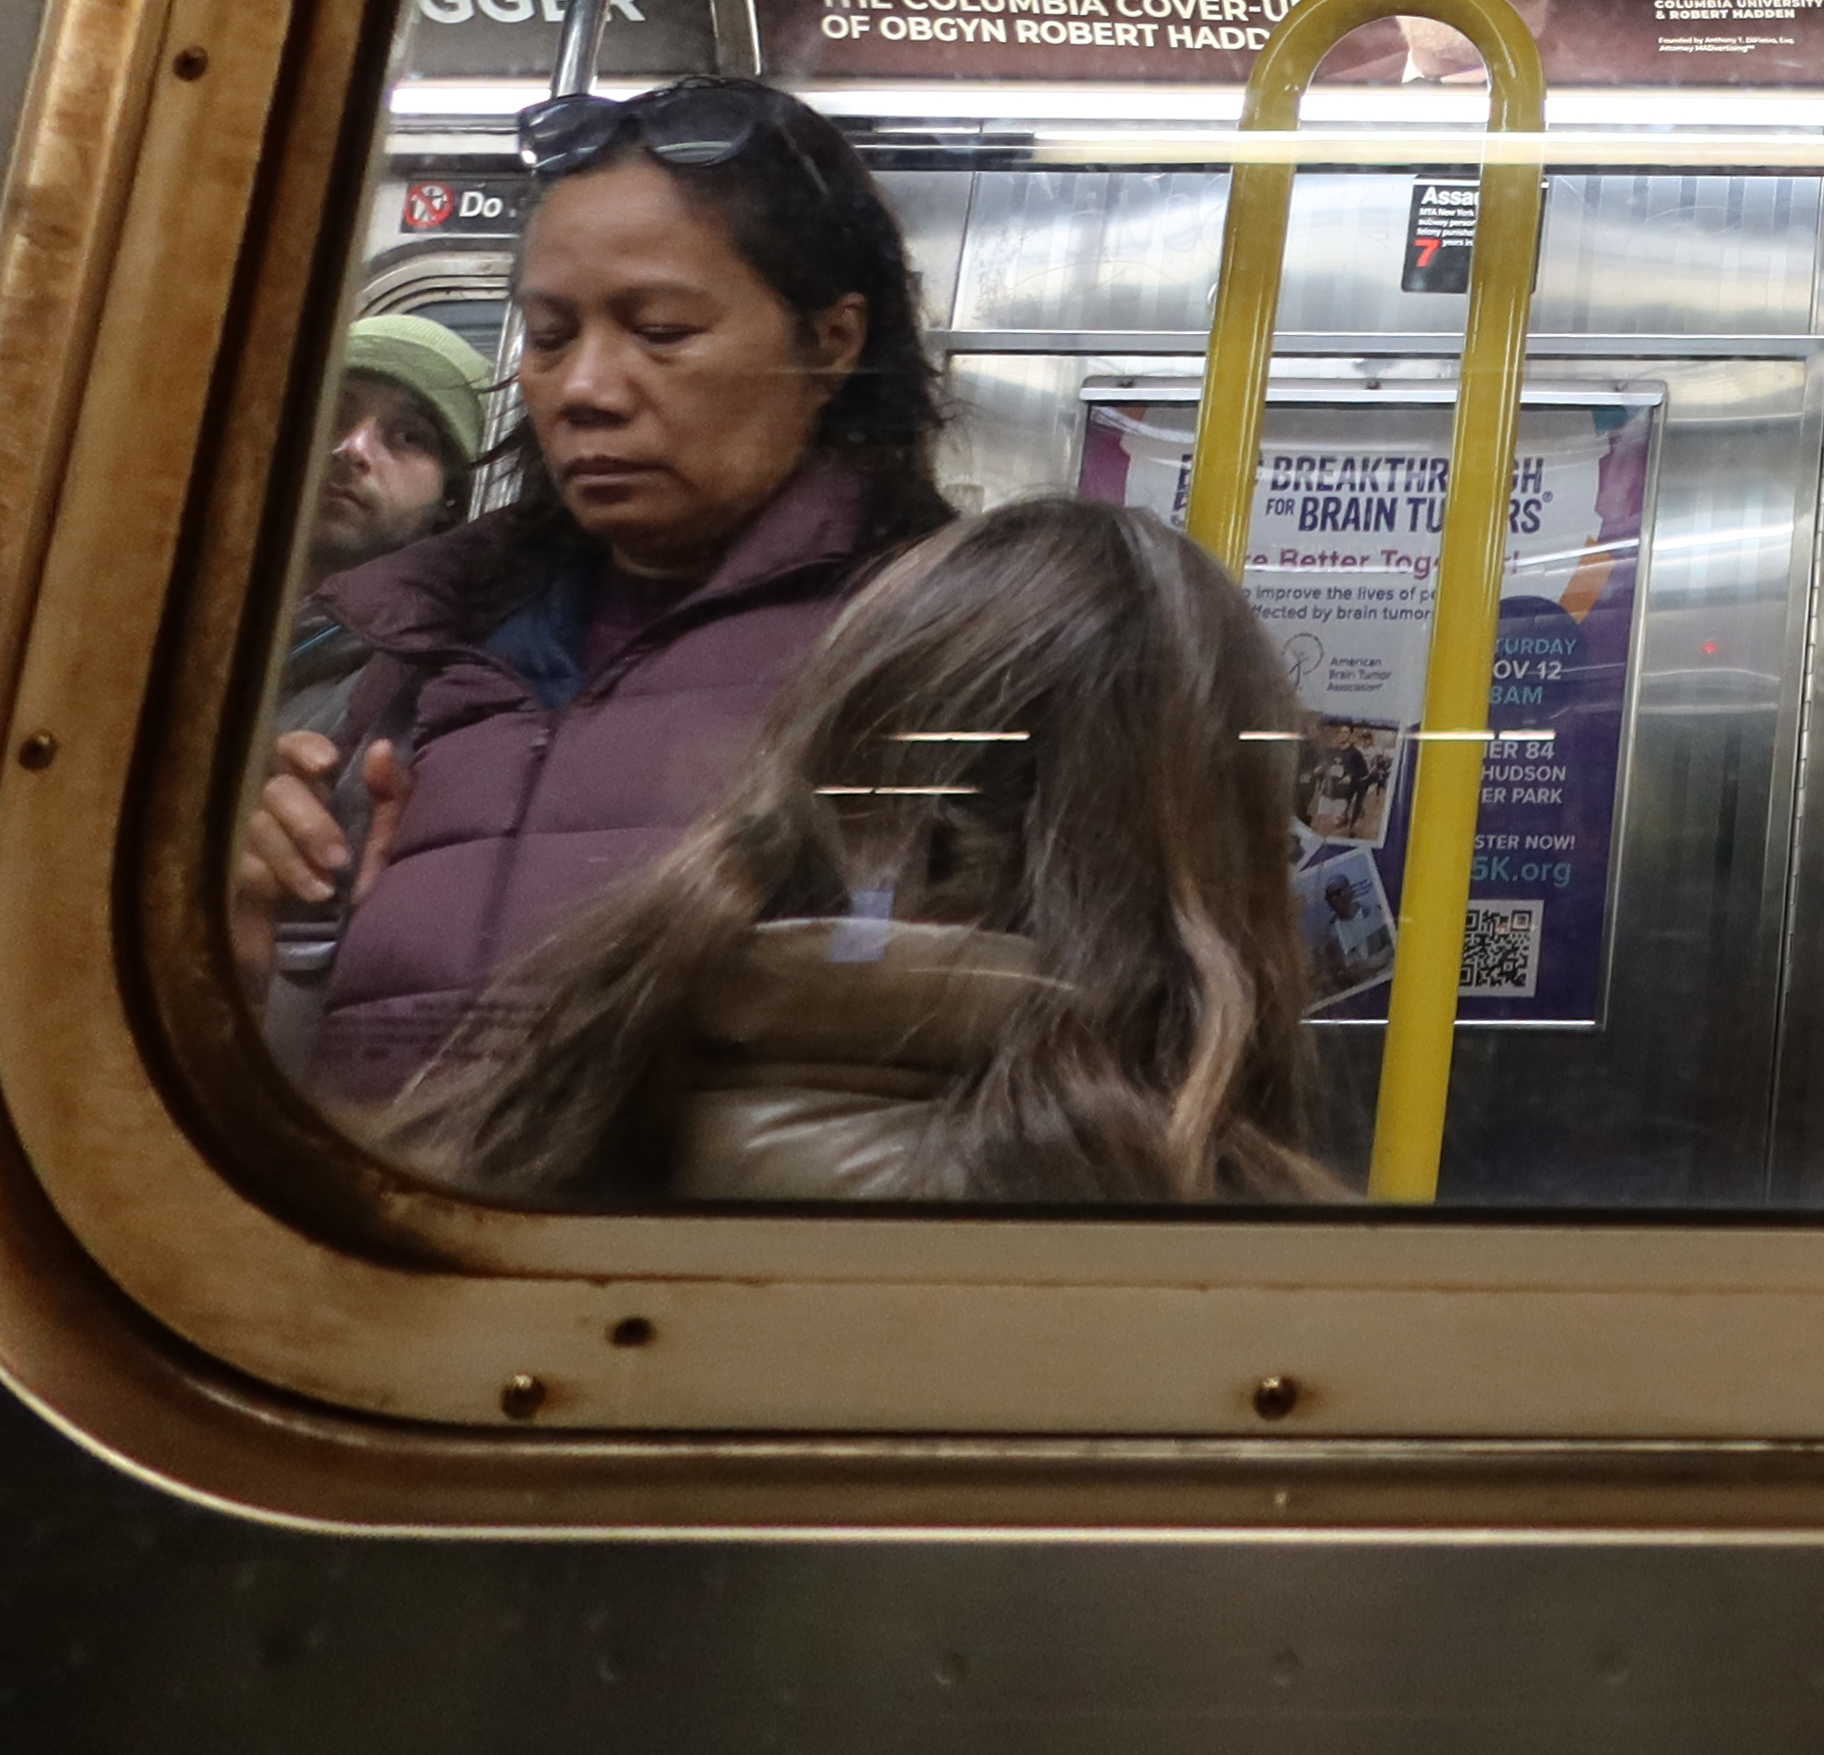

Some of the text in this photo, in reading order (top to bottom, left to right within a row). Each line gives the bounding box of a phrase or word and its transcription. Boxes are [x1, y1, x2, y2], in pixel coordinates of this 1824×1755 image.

[1654, 0, 1733, 9] COLUMBIA
[1655, 9, 1796, 20] & ROBERT HADDEN
[821, 15, 871, 40] OF
[880, 16, 1008, 44] OBGYN
[1017, 20, 1160, 48] ROBERT
[459, 191, 503, 218] Do
[1413, 238, 1440, 267] 7
[1265, 496, 1542, 534] FOR BRAIN TURS
[1256, 586, 1322, 602] improve
[1327, 586, 1352, 600] the
[1357, 586, 1394, 600] lives
[1399, 585, 1417, 600] of
[1312, 606, 1333, 623] by
[1337, 605, 1377, 620] brain
[1328, 670, 1393, 680] Brain Tumor
[1537, 660, 1562, 680] 12
[1525, 741, 1555, 760] 84
[1481, 765, 1567, 782] HUDSON
[1511, 787, 1563, 804] PARK
[1525, 834, 1576, 850] NOW!
